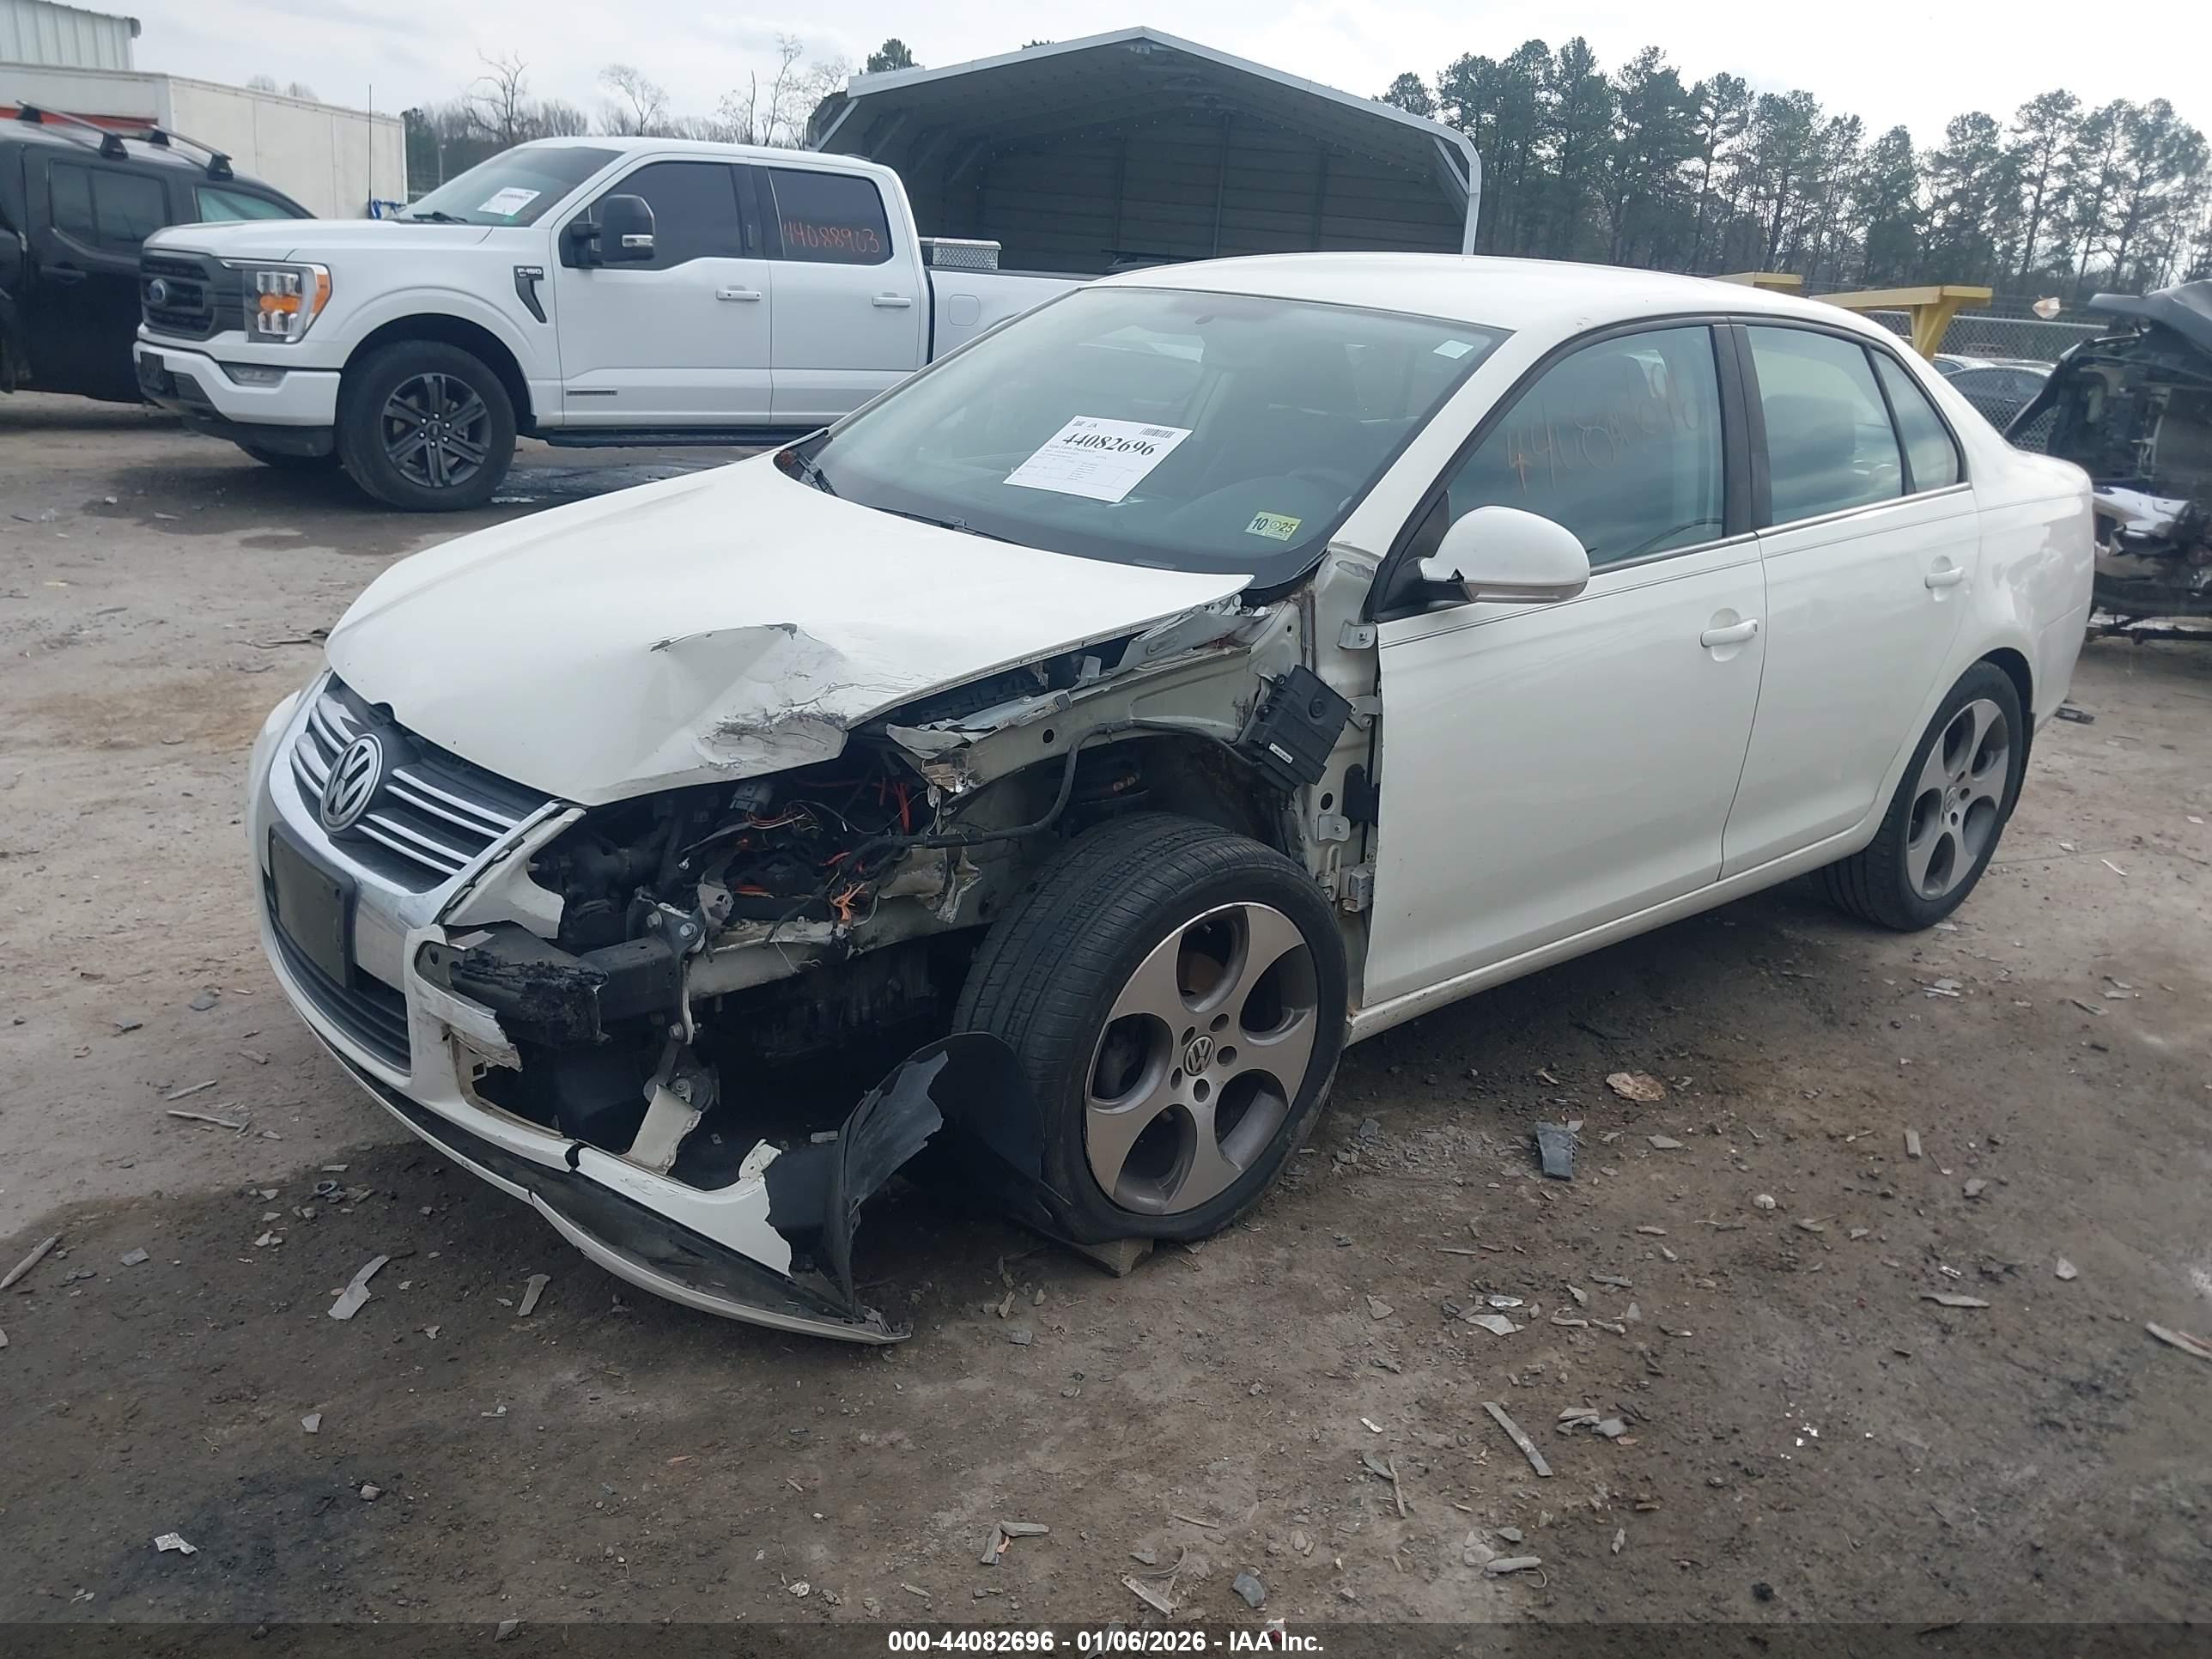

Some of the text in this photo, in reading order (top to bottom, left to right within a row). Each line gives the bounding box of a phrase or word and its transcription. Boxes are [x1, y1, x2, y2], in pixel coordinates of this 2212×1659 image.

[783, 221, 880, 252] 44088903
[1062, 432, 1161, 456] 44082696
[1251, 517, 1296, 533] 10 25
